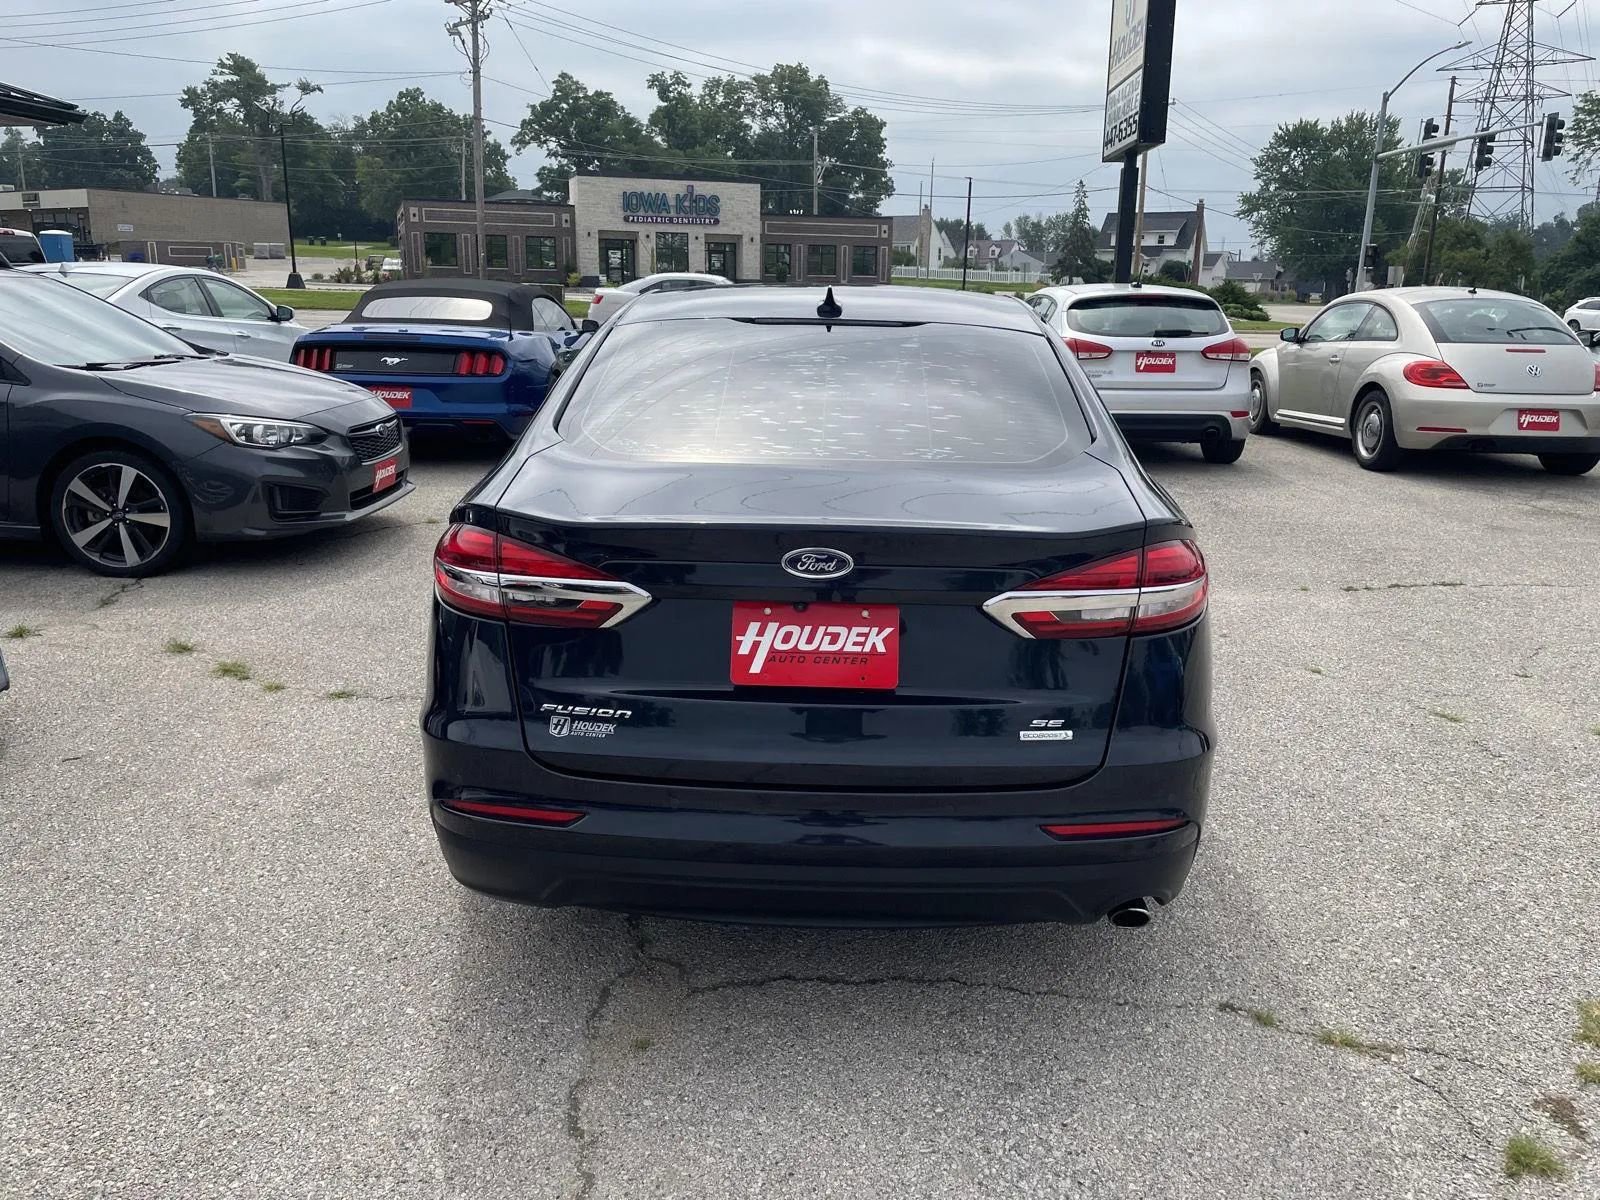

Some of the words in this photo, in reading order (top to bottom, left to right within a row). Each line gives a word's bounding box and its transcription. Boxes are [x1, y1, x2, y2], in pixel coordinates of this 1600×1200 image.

[1104, 111, 1138, 150] 447-6355
[623, 191, 671, 214] IOWA
[628, 216, 670, 224] PEDIATRIC
[673, 217, 715, 225] DENTISTRY
[1137, 356, 1175, 370] HOUDEK
[1519, 414, 1559, 428] HOUDEK
[375, 464, 396, 489] HOUDEK
[797, 553, 836, 571] Ford
[735, 621, 895, 674] HOUDEK
[768, 655, 807, 665] AUTO
[813, 656, 869, 666] CENTER
[540, 703, 632, 719] FUSION
[571, 720, 616, 735] HOUDEK
[1029, 719, 1065, 727] SE
